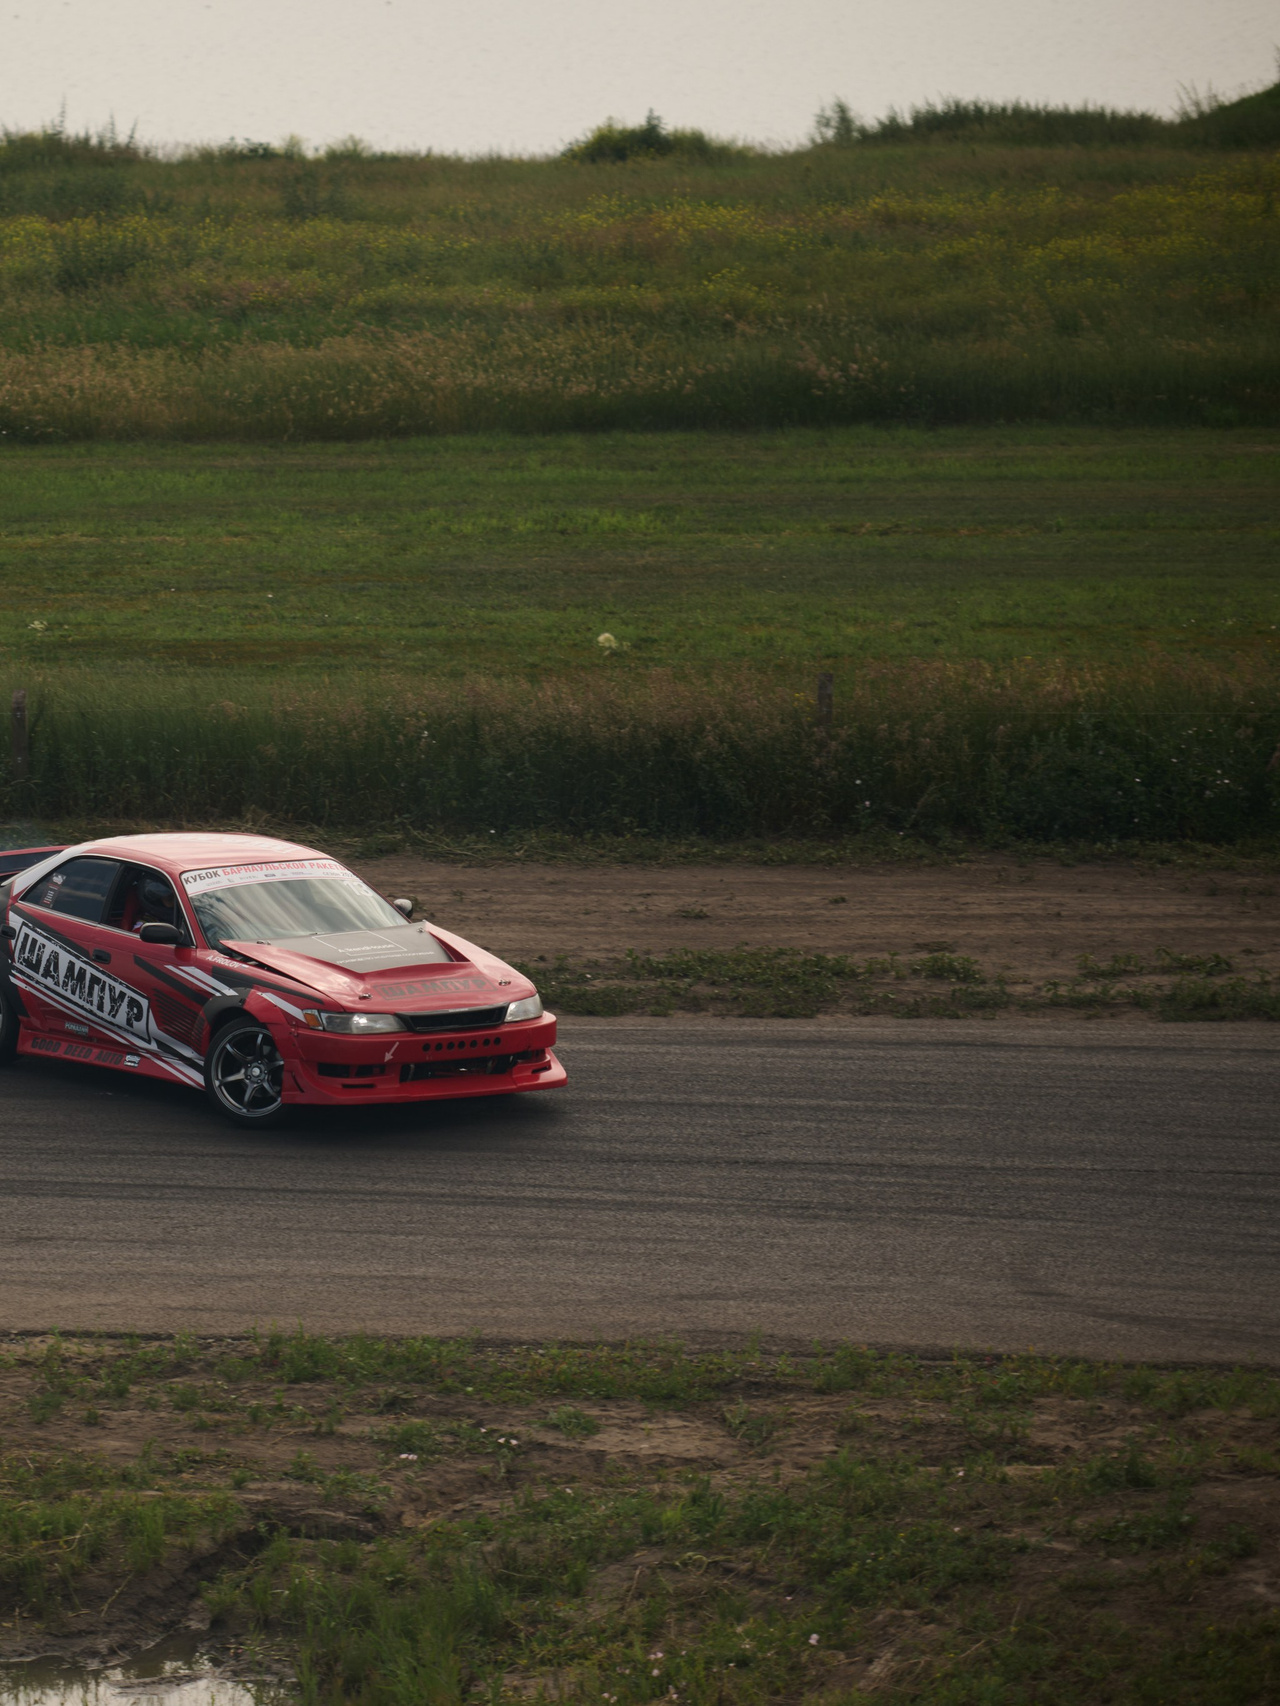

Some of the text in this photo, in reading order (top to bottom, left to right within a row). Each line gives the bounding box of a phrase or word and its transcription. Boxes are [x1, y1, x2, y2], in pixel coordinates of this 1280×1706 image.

[184, 869, 221, 885] КУБОК
[17, 932, 144, 1029] ШАМПУР
[379, 978, 488, 998] ШАМПУР
[30, 1037, 62, 1053] GOOD
